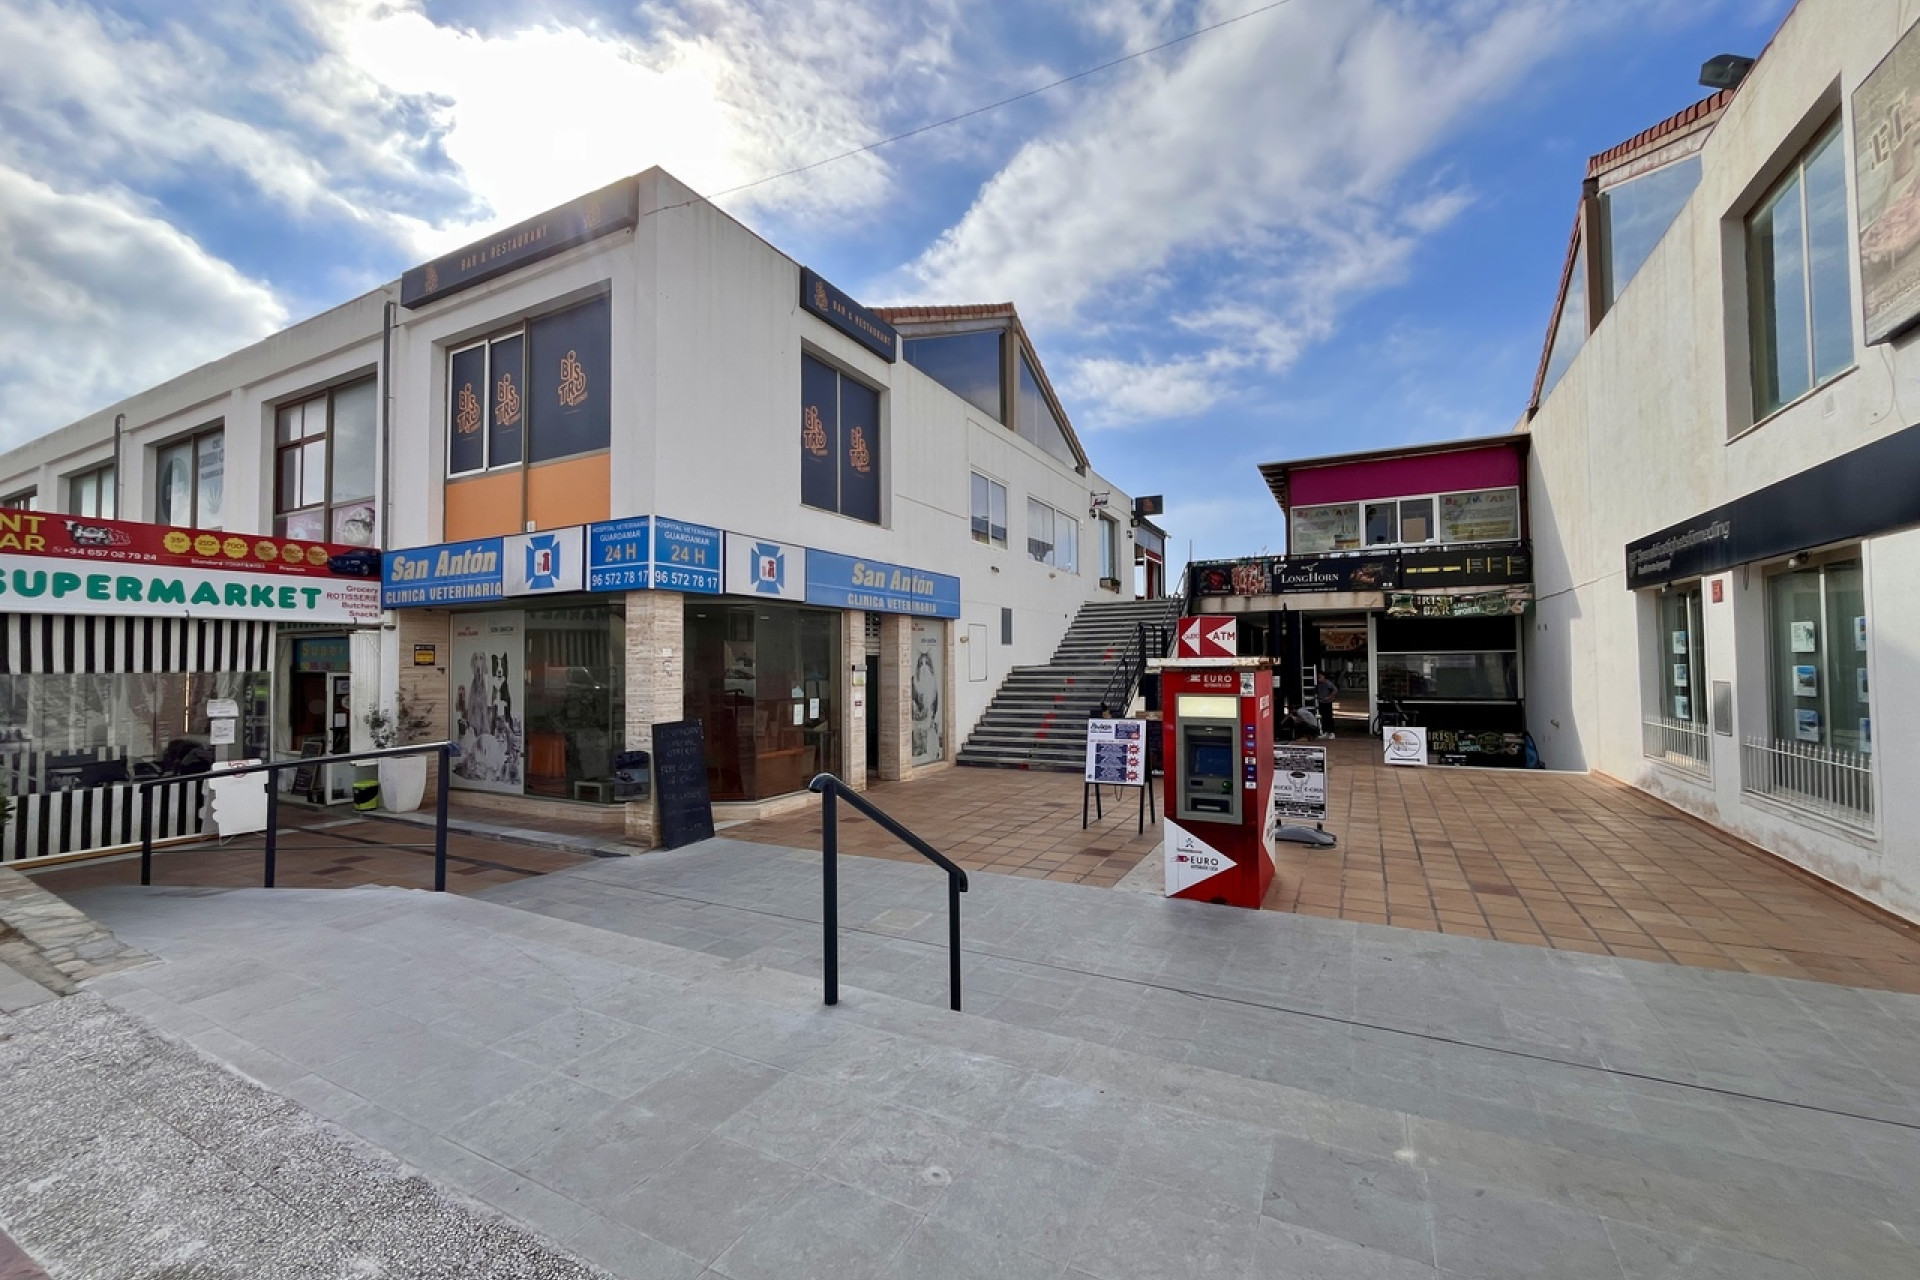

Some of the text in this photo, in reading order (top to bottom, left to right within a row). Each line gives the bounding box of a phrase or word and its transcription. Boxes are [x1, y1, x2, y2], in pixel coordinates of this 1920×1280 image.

[461, 255, 477, 271] BAR
[491, 224, 547, 258] RESTAURANT
[600, 530, 641, 542] GUARDAMAR
[664, 531, 710, 545] GUARDAMAR
[87, 549, 108, 557] 657
[605, 542, 637, 563] 24 H
[671, 545, 706, 565] 24 H
[391, 546, 497, 581] San Antón
[592, 570, 649, 587] 96 572 78 17
[655, 570, 718, 589] 96 572 78 17
[852, 562, 934, 596] San Antón
[0, 567, 322, 609] UPERMARKET
[346, 585, 379, 594] Grocery
[386, 582, 502, 604] CLINICA VETERINARIA
[327, 592, 379, 602] ROTISSERIE
[847, 592, 937, 614] CLINICA VETERINARIA
[342, 602, 379, 610] Butchers
[349, 610, 379, 618] Snacks
[1212, 631, 1236, 640] ATM
[1203, 674, 1232, 683] EURO
[1190, 856, 1219, 866] EURO
